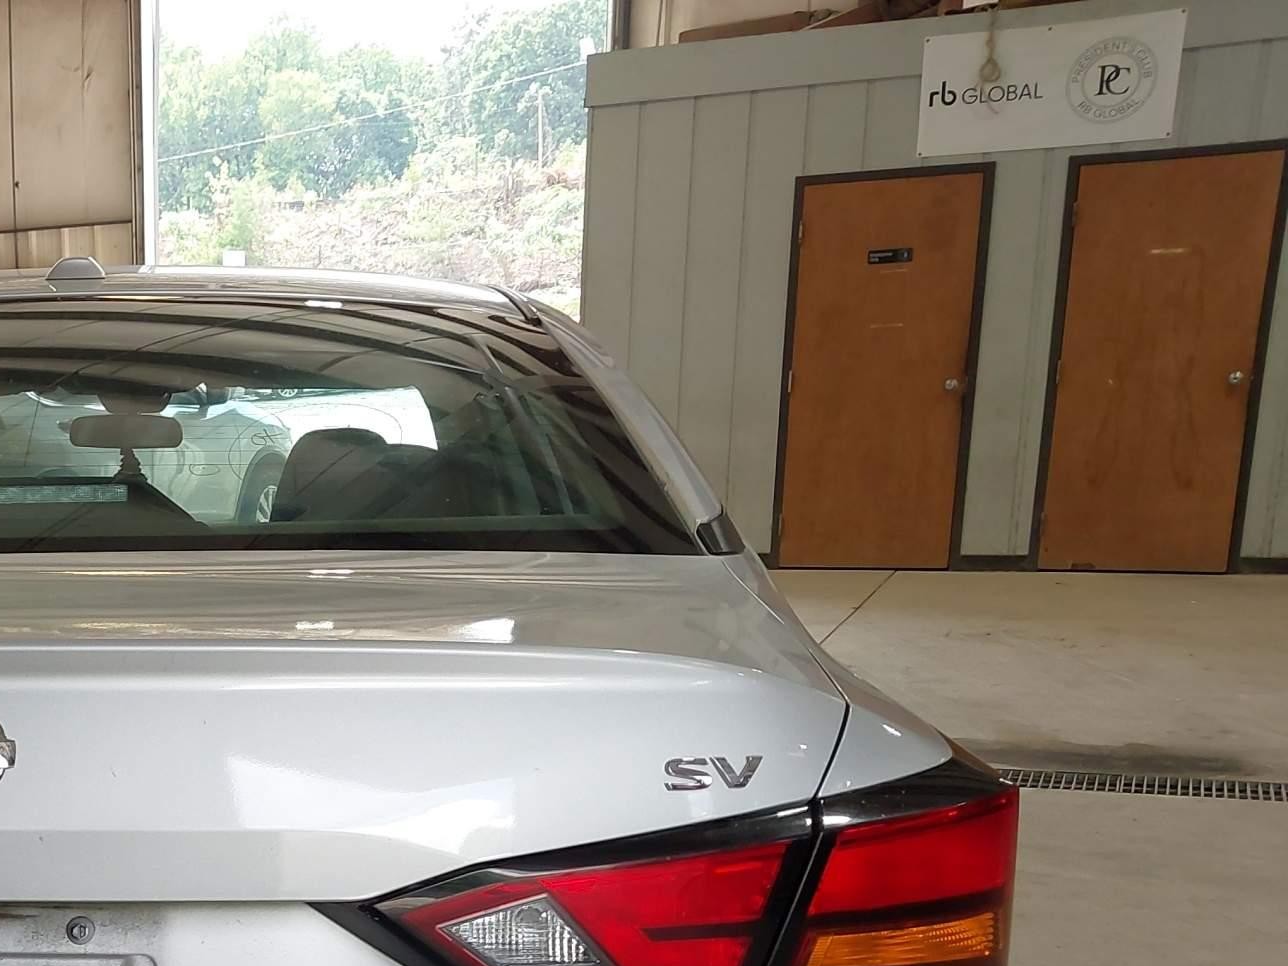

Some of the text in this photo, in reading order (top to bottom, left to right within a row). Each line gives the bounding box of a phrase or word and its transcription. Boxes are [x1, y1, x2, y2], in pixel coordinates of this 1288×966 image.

[928, 80, 1044, 108] rb GLOBAL
[663, 755, 764, 792] SV
